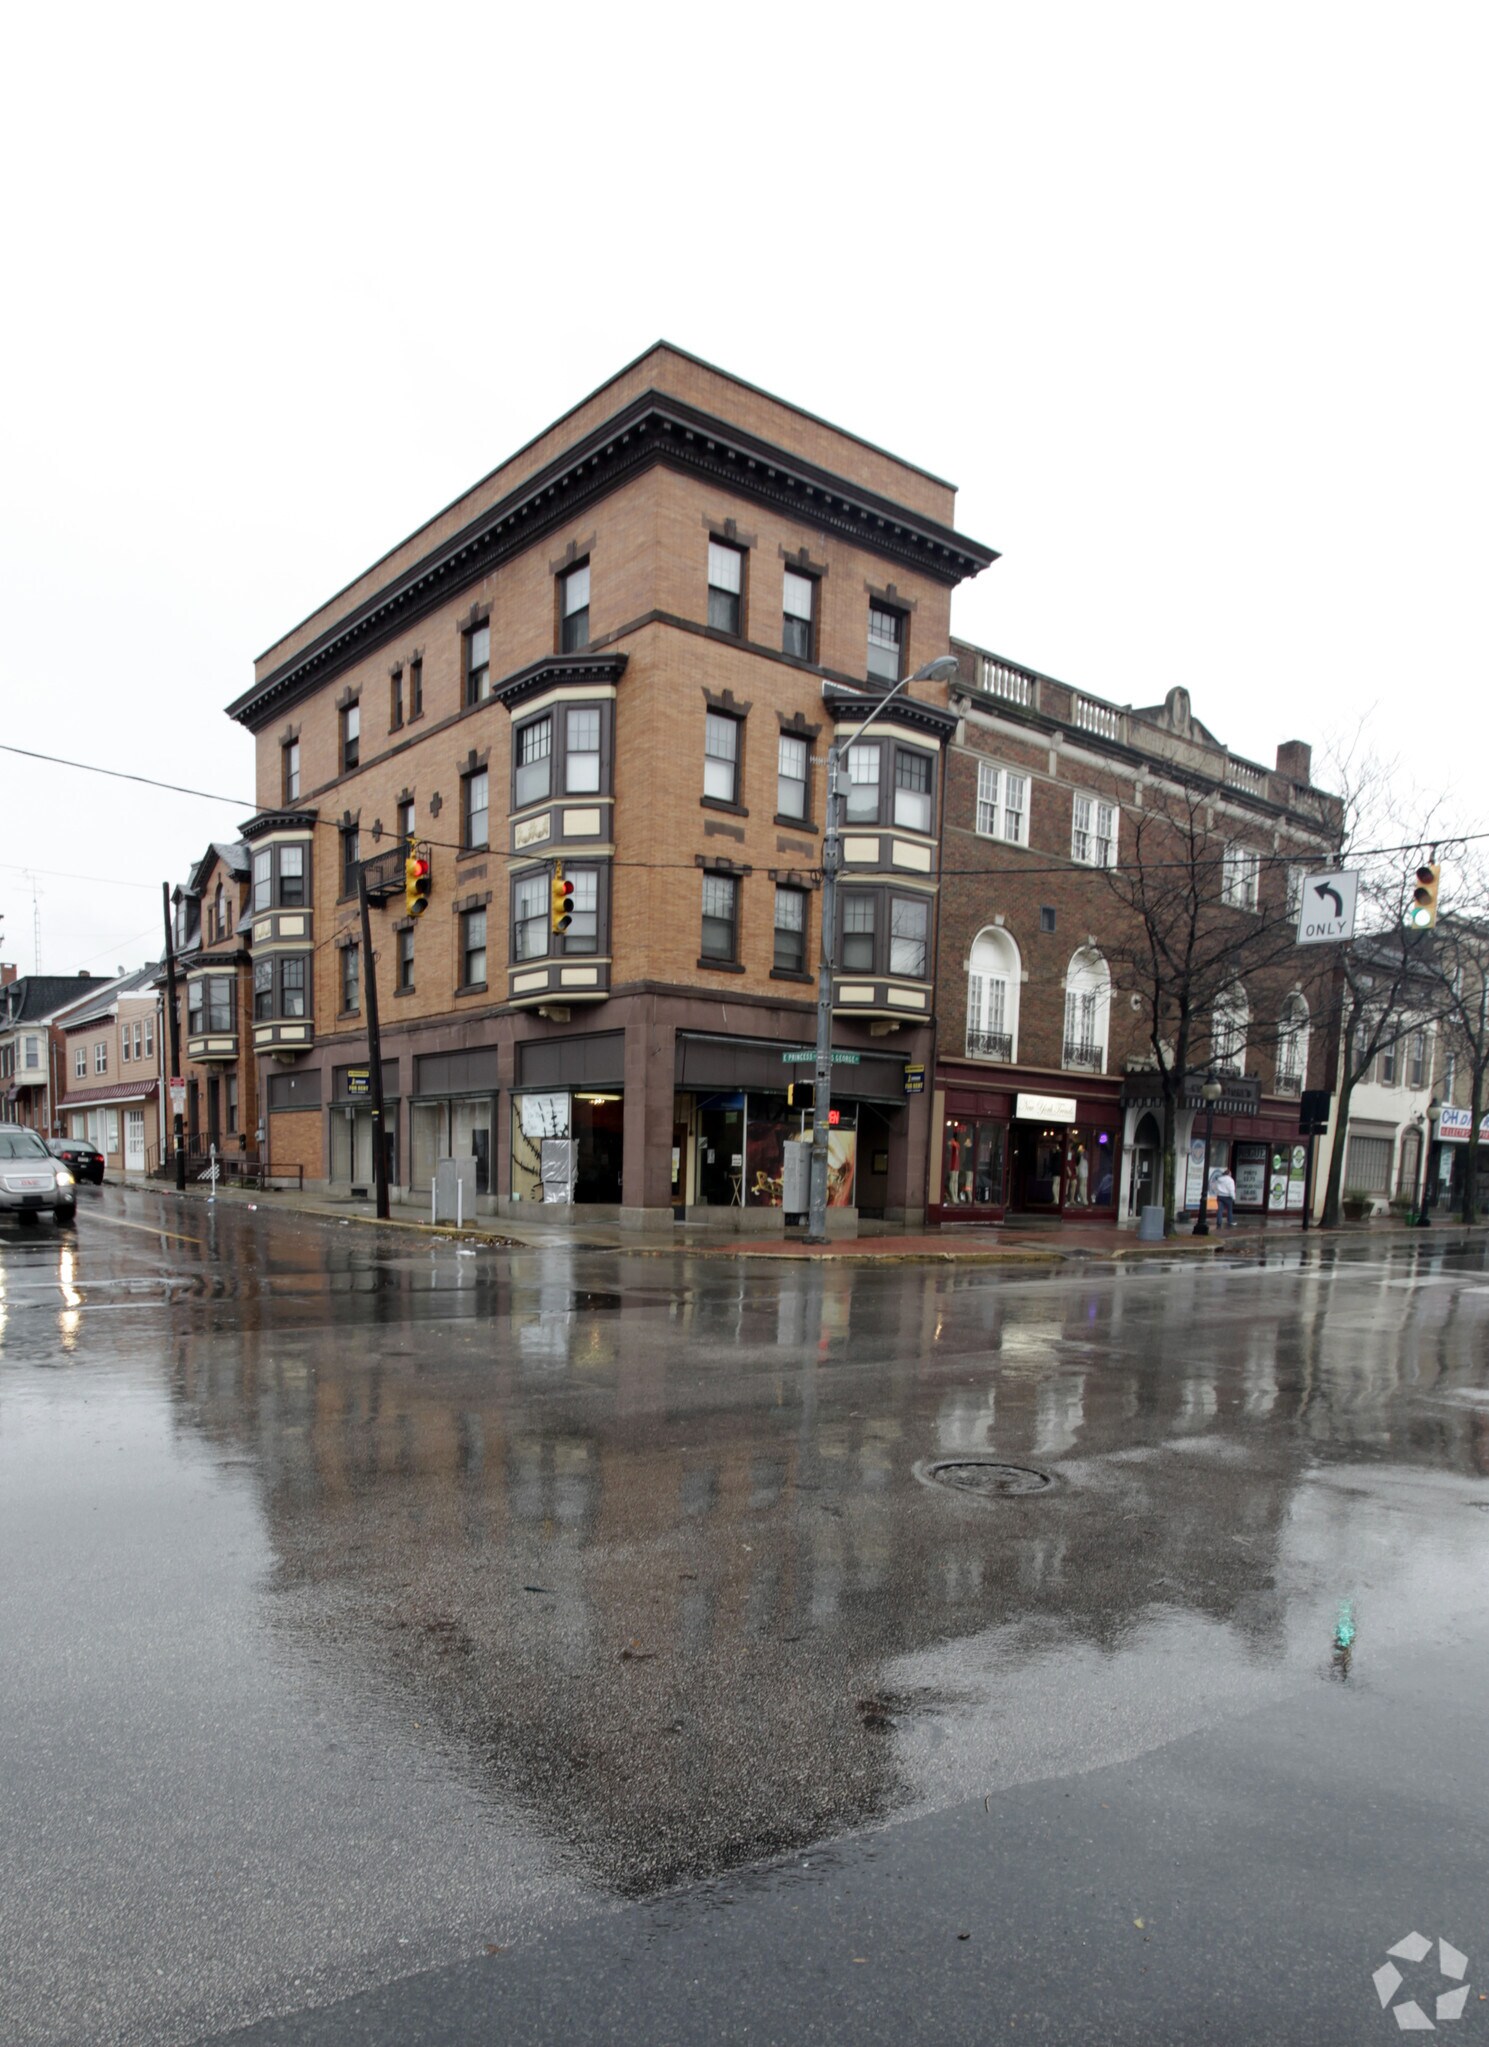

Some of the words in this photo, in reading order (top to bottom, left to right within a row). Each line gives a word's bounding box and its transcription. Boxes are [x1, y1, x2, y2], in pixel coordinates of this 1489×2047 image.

[1306, 921, 1347, 937] ONLY
[788, 1053, 813, 1062] PRINCESS
[836, 1054, 856, 1063] GEORGE
